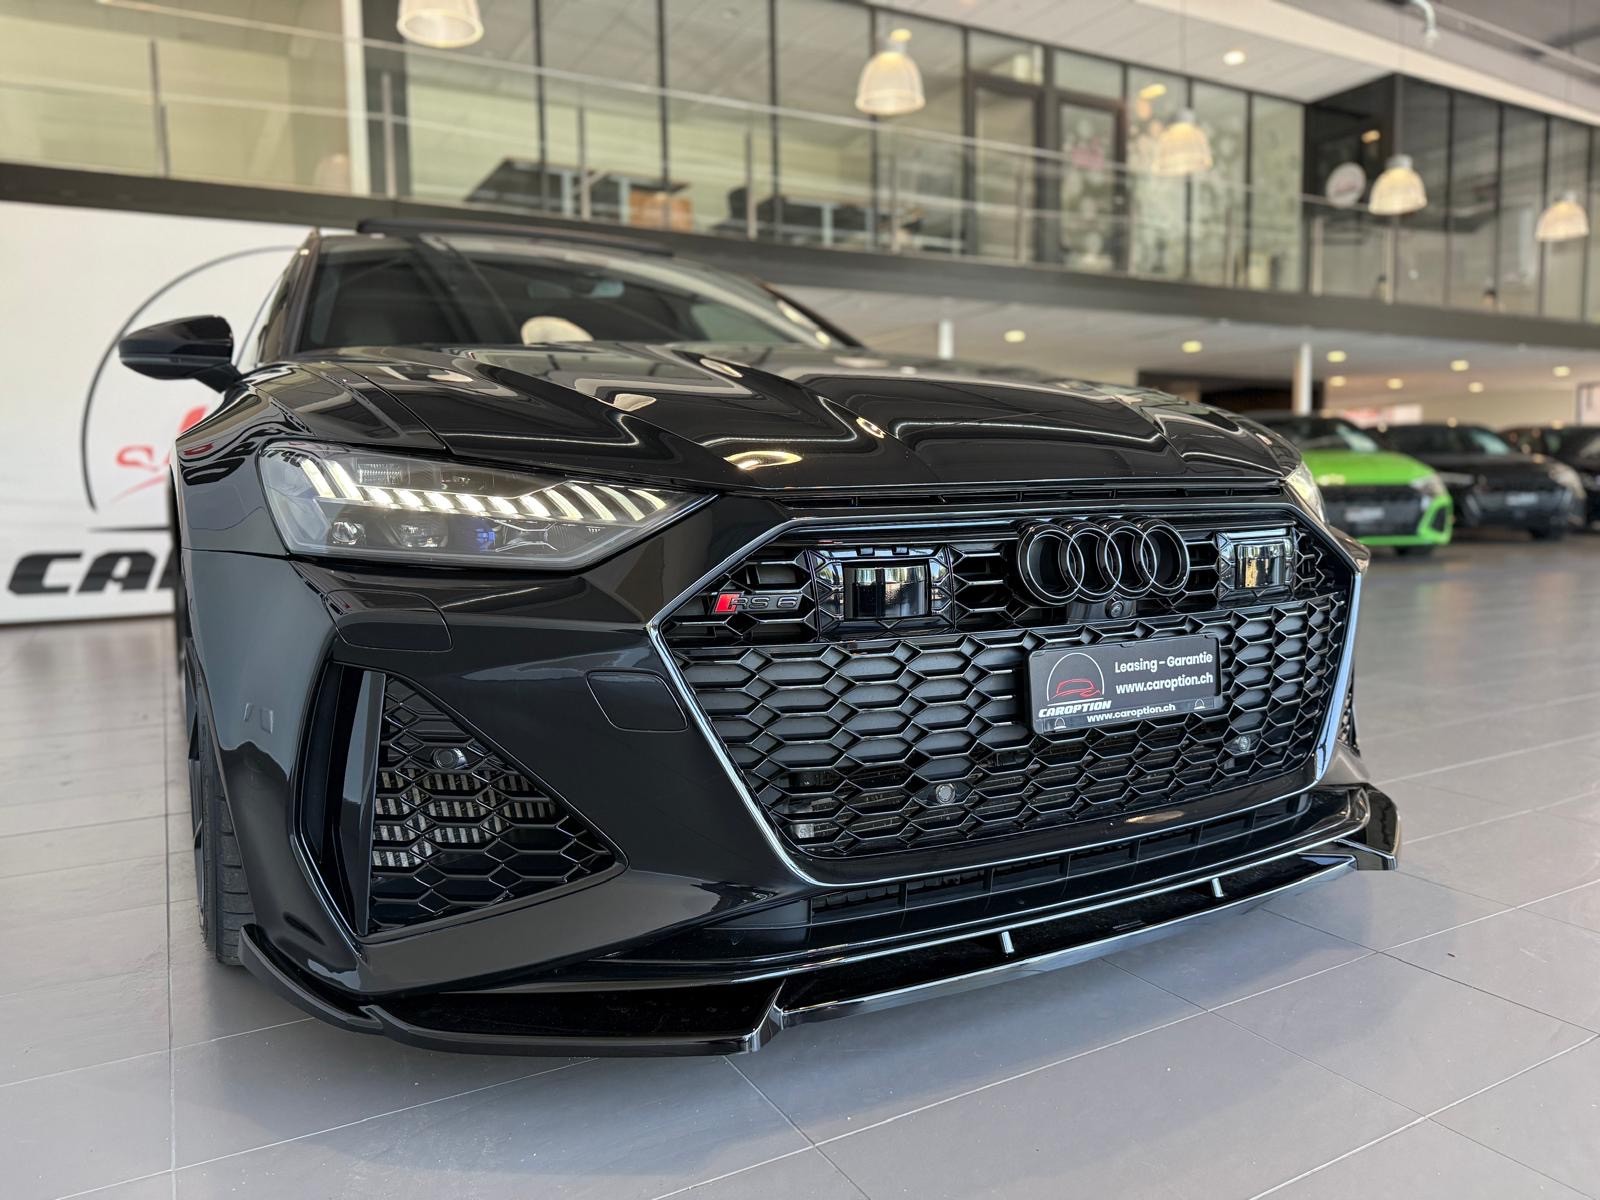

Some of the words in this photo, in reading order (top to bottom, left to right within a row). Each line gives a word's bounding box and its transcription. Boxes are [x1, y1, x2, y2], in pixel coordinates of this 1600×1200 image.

[8, 550, 174, 594] CA
[1116, 672, 1213, 694] www.caroption.ch
[1038, 700, 1112, 718] CAROPTION
[1087, 703, 1176, 723] www.caroption.ch
